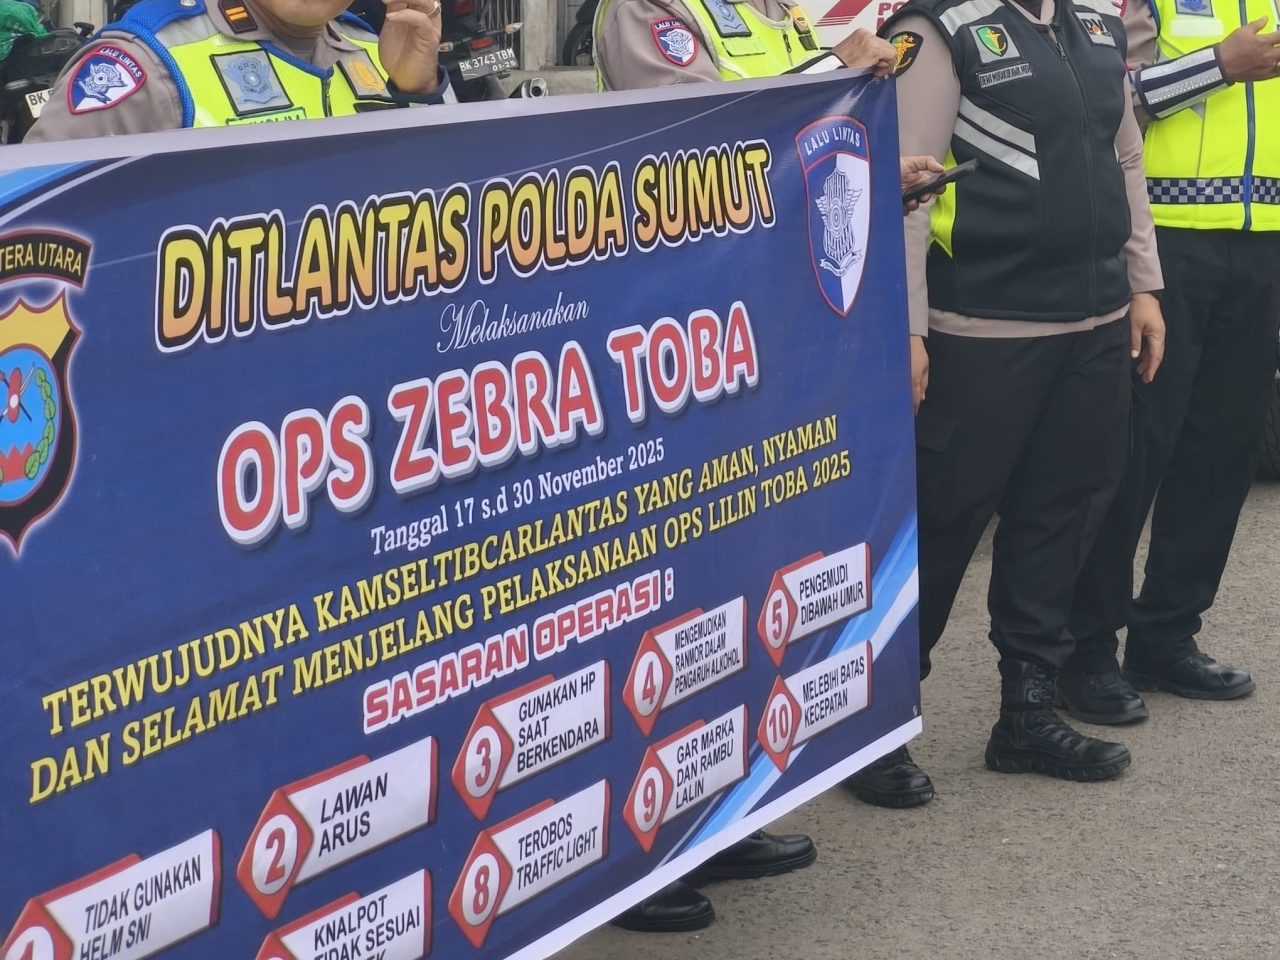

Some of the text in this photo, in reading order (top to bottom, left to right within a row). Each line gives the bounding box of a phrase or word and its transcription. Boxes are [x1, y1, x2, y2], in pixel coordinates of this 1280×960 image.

[100, 47, 143, 78] LALU LINTAS
[459, 60, 473, 72] BK
[472, 53, 497, 68] 3743
[492, 60, 516, 72] 01-25
[28, 91, 47, 106] BK
[804, 126, 861, 156] LALU LINTAS
[38, 242, 82, 276] UTARA
[156, 140, 777, 351] DITLANTAS POLDA SUMUT
[436, 291, 590, 353] Melaksanakan
[217, 300, 758, 544] OPS ZEBRA TOBA
[371, 437, 665, 556] Tanggal 17 s.d 30 November 2025
[42, 414, 838, 737] TERWUJUDNYA KAMSELTIBCARLANTAS YANG AMAN, NYAMAN
[799, 562, 849, 599] PENGEMUDI
[29, 449, 851, 804] DAN SELAMAT MENJELANG PELAKSANAAN OPS LILIN TOBA 2025
[771, 598, 783, 640] 5
[800, 581, 864, 626] DIBAWAH UMUR
[674, 609, 727, 651] MENGEMUDIKAN
[675, 631, 727, 674] RANMOR DALAM
[363, 624, 528, 734] SASARAN
[641, 660, 656, 706] 4
[674, 648, 741, 696] PENGARUH ALKOHOL
[802, 655, 866, 703] MELEBIHI BATAS
[518, 671, 596, 723] GUNAKAN HP
[804, 687, 849, 729] KECEPATAN
[517, 717, 599, 773] BERKENDARA
[518, 715, 550, 748] SAAT
[676, 717, 734, 765] GAR MARKA
[768, 703, 789, 745] 10
[474, 737, 491, 788] 3
[676, 738, 734, 788] DAN RAMBU
[320, 772, 388, 824] LAWAN
[642, 776, 657, 823] 9
[675, 778, 705, 809] LALIN
[265, 828, 286, 886] 2
[318, 810, 371, 857] ARUS
[518, 812, 573, 862] TEROBOS
[516, 825, 598, 891] TRAFFIC LIGHT
[85, 854, 202, 934] TIDAK GUNAKAN
[472, 864, 489, 916] 8
[80, 913, 152, 960] HELM SNI
[314, 894, 388, 951] KNALPOT
[314, 905, 421, 960] DAK SESUAI
